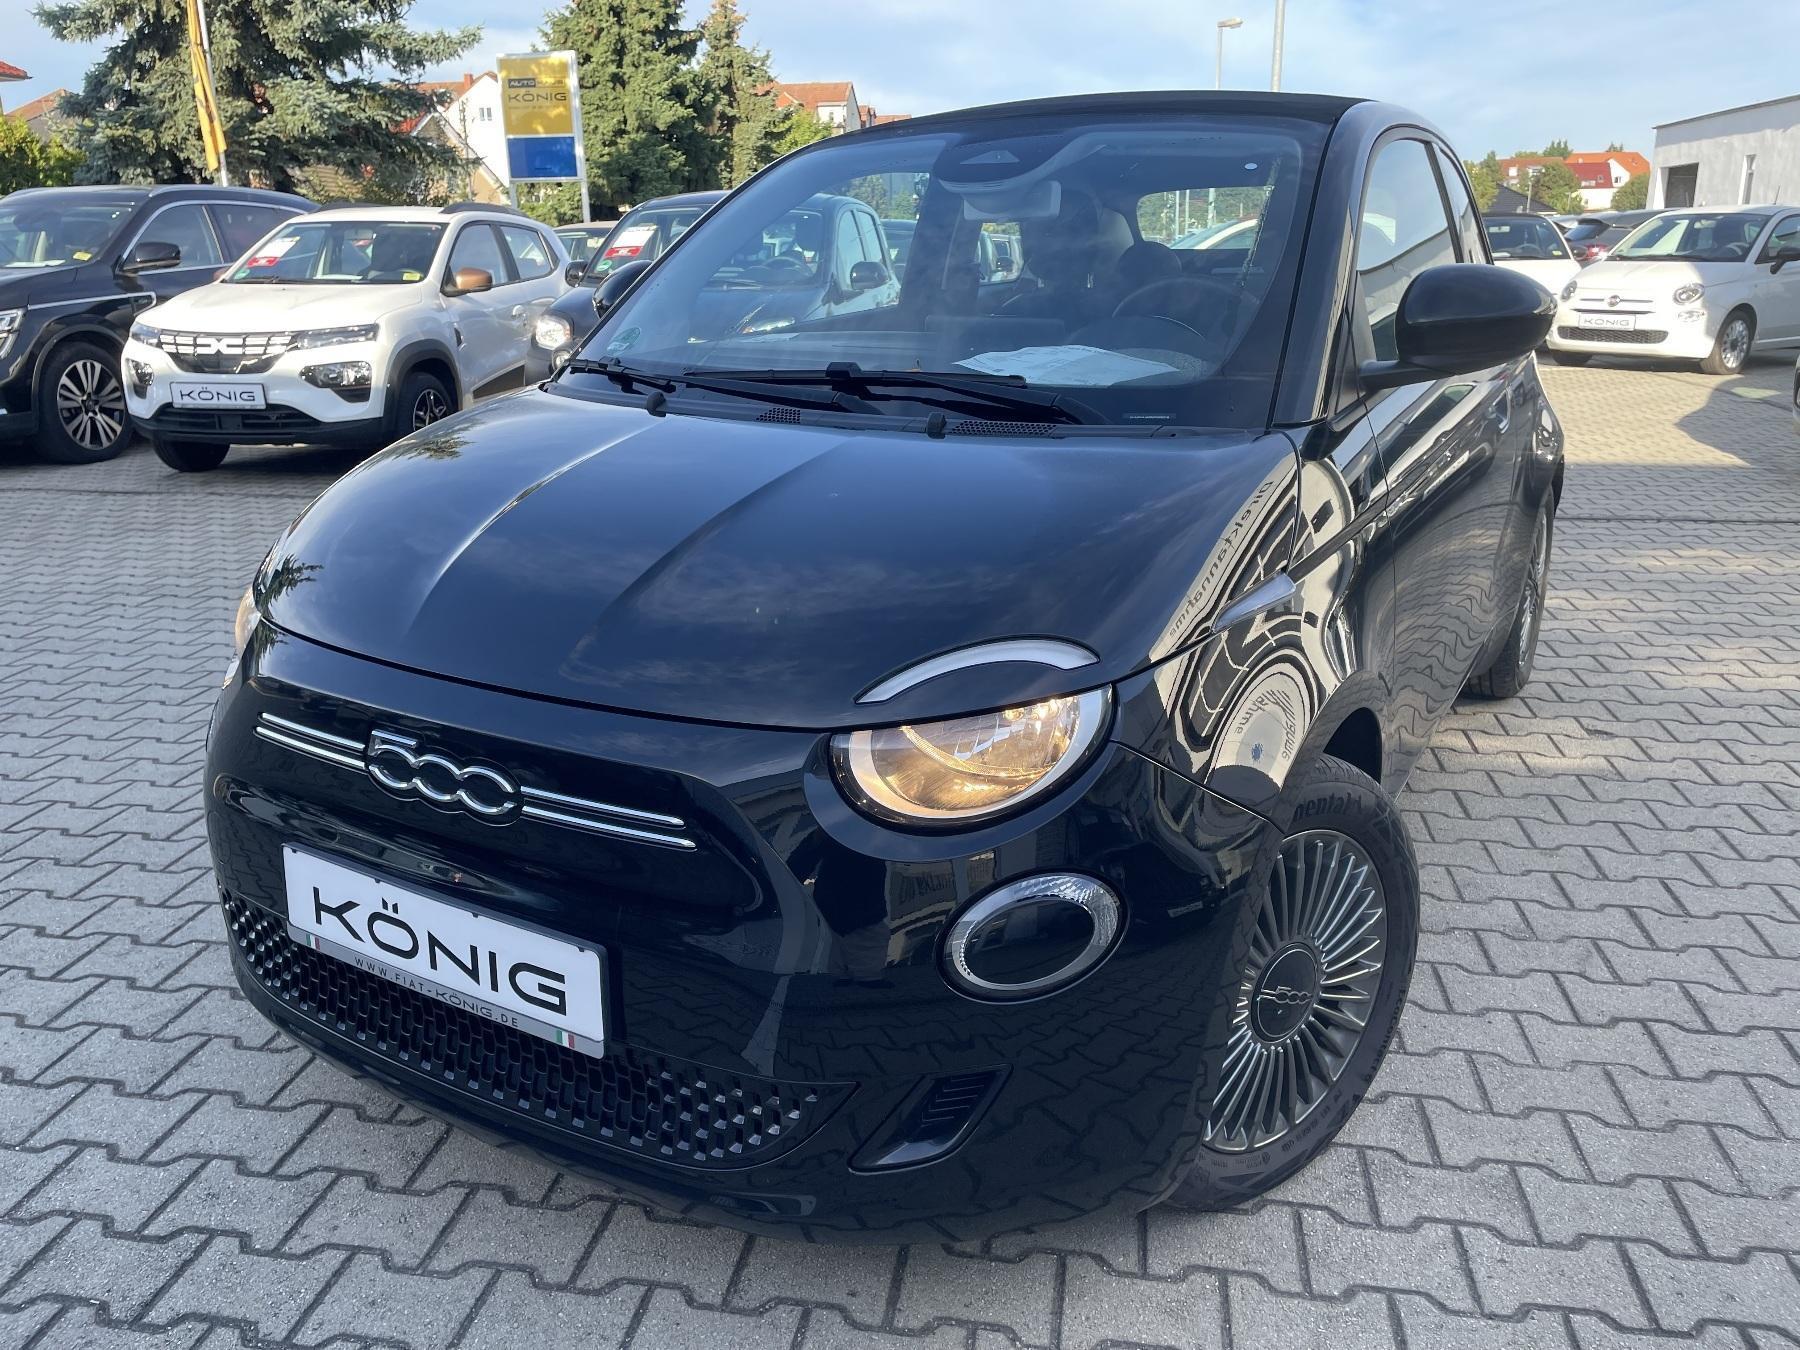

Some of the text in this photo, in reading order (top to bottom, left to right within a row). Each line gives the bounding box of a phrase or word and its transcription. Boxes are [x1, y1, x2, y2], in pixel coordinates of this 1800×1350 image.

[508, 91, 567, 102] KÖNIG
[180, 386, 255, 401] KÖNIG
[368, 729, 518, 815] 500
[313, 887, 567, 1016] KÖNIG
[355, 956, 519, 1028] WWW.FIAT-KÖNIG.DE
